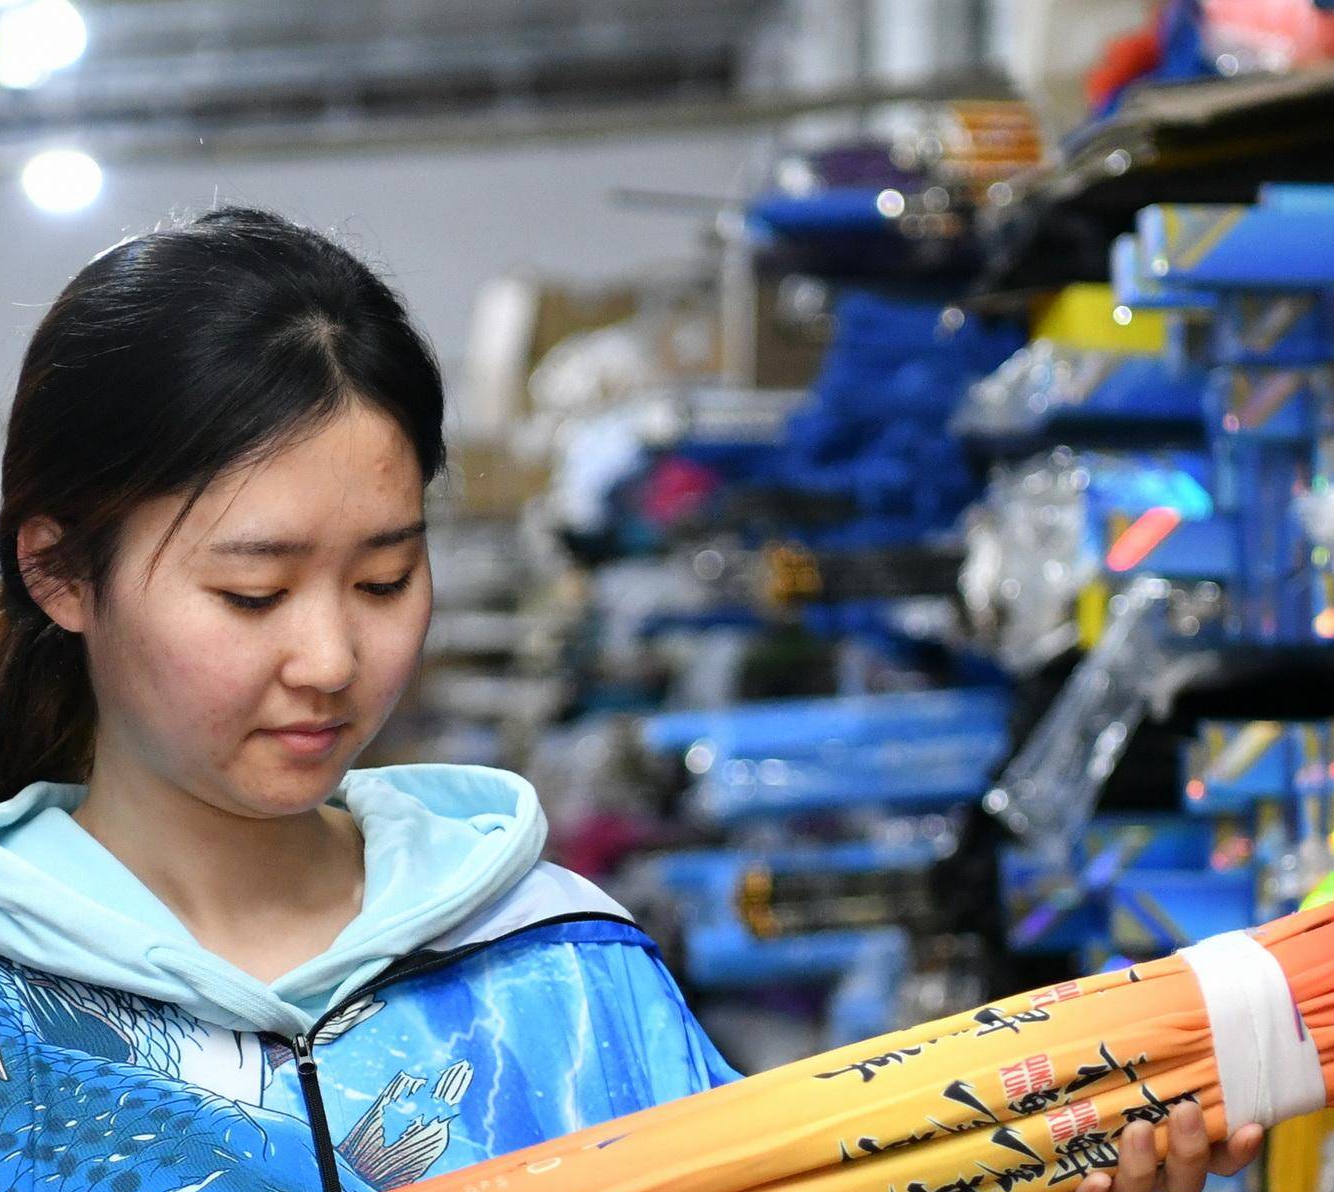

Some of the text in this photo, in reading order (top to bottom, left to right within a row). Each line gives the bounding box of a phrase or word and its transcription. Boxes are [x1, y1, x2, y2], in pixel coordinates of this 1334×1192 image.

[1000, 1062, 1029, 1099] XUN
[1025, 1053, 1054, 1092] QING
[1046, 1108, 1074, 1143] XUN
[1069, 1100, 1099, 1135] QING
